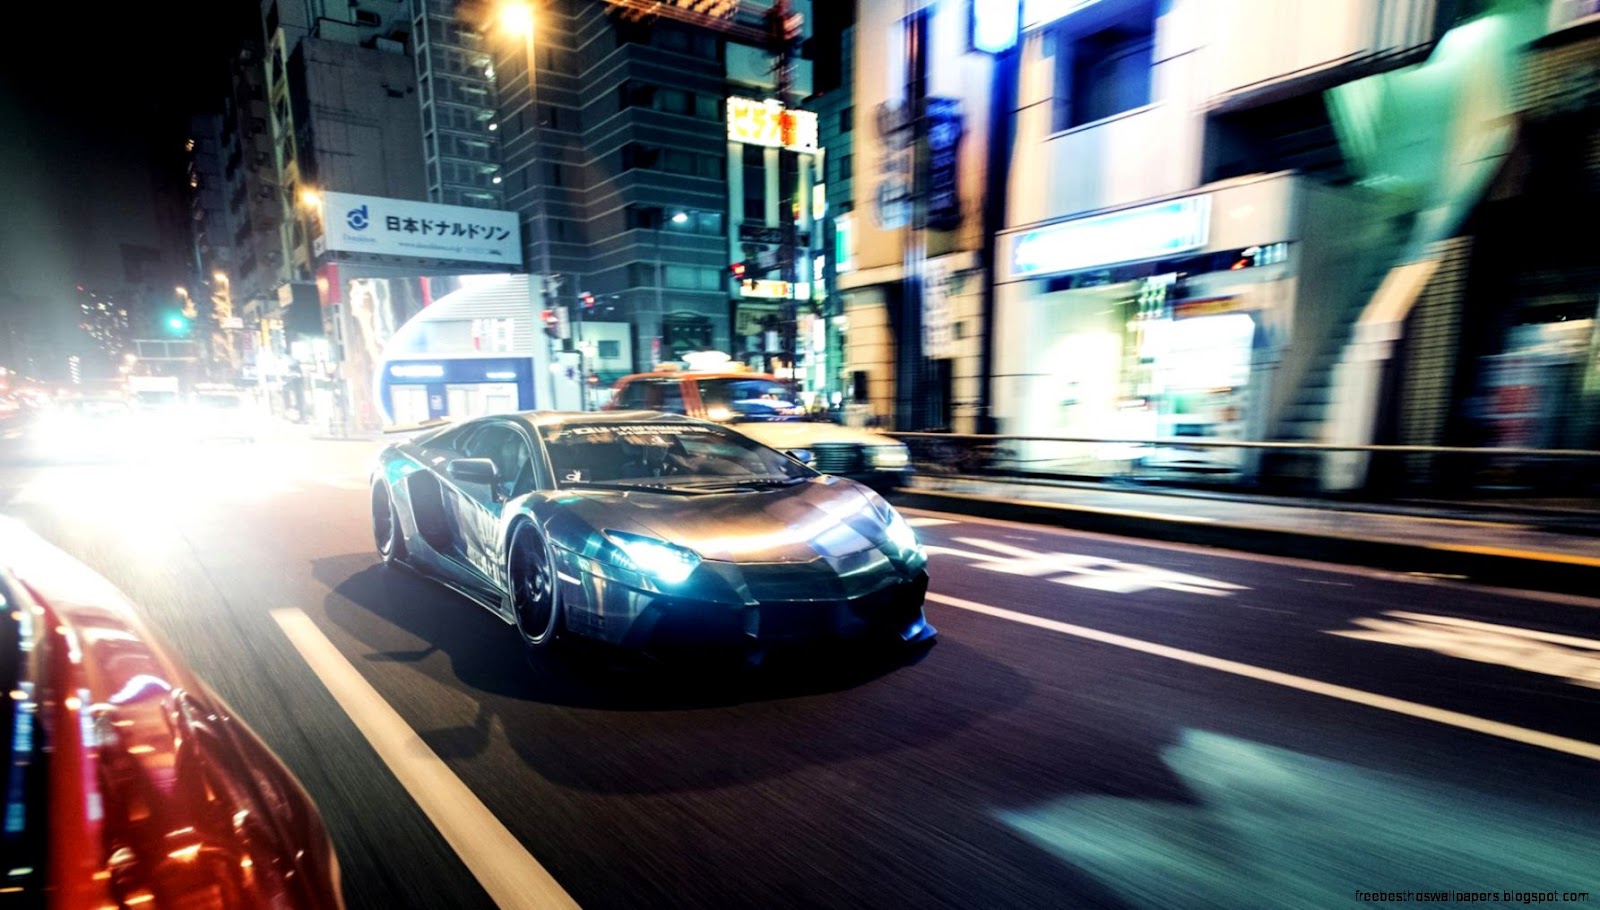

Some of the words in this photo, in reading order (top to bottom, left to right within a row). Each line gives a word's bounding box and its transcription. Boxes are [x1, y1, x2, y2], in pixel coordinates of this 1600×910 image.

[385, 214, 511, 241] 日本ドナルドソン
